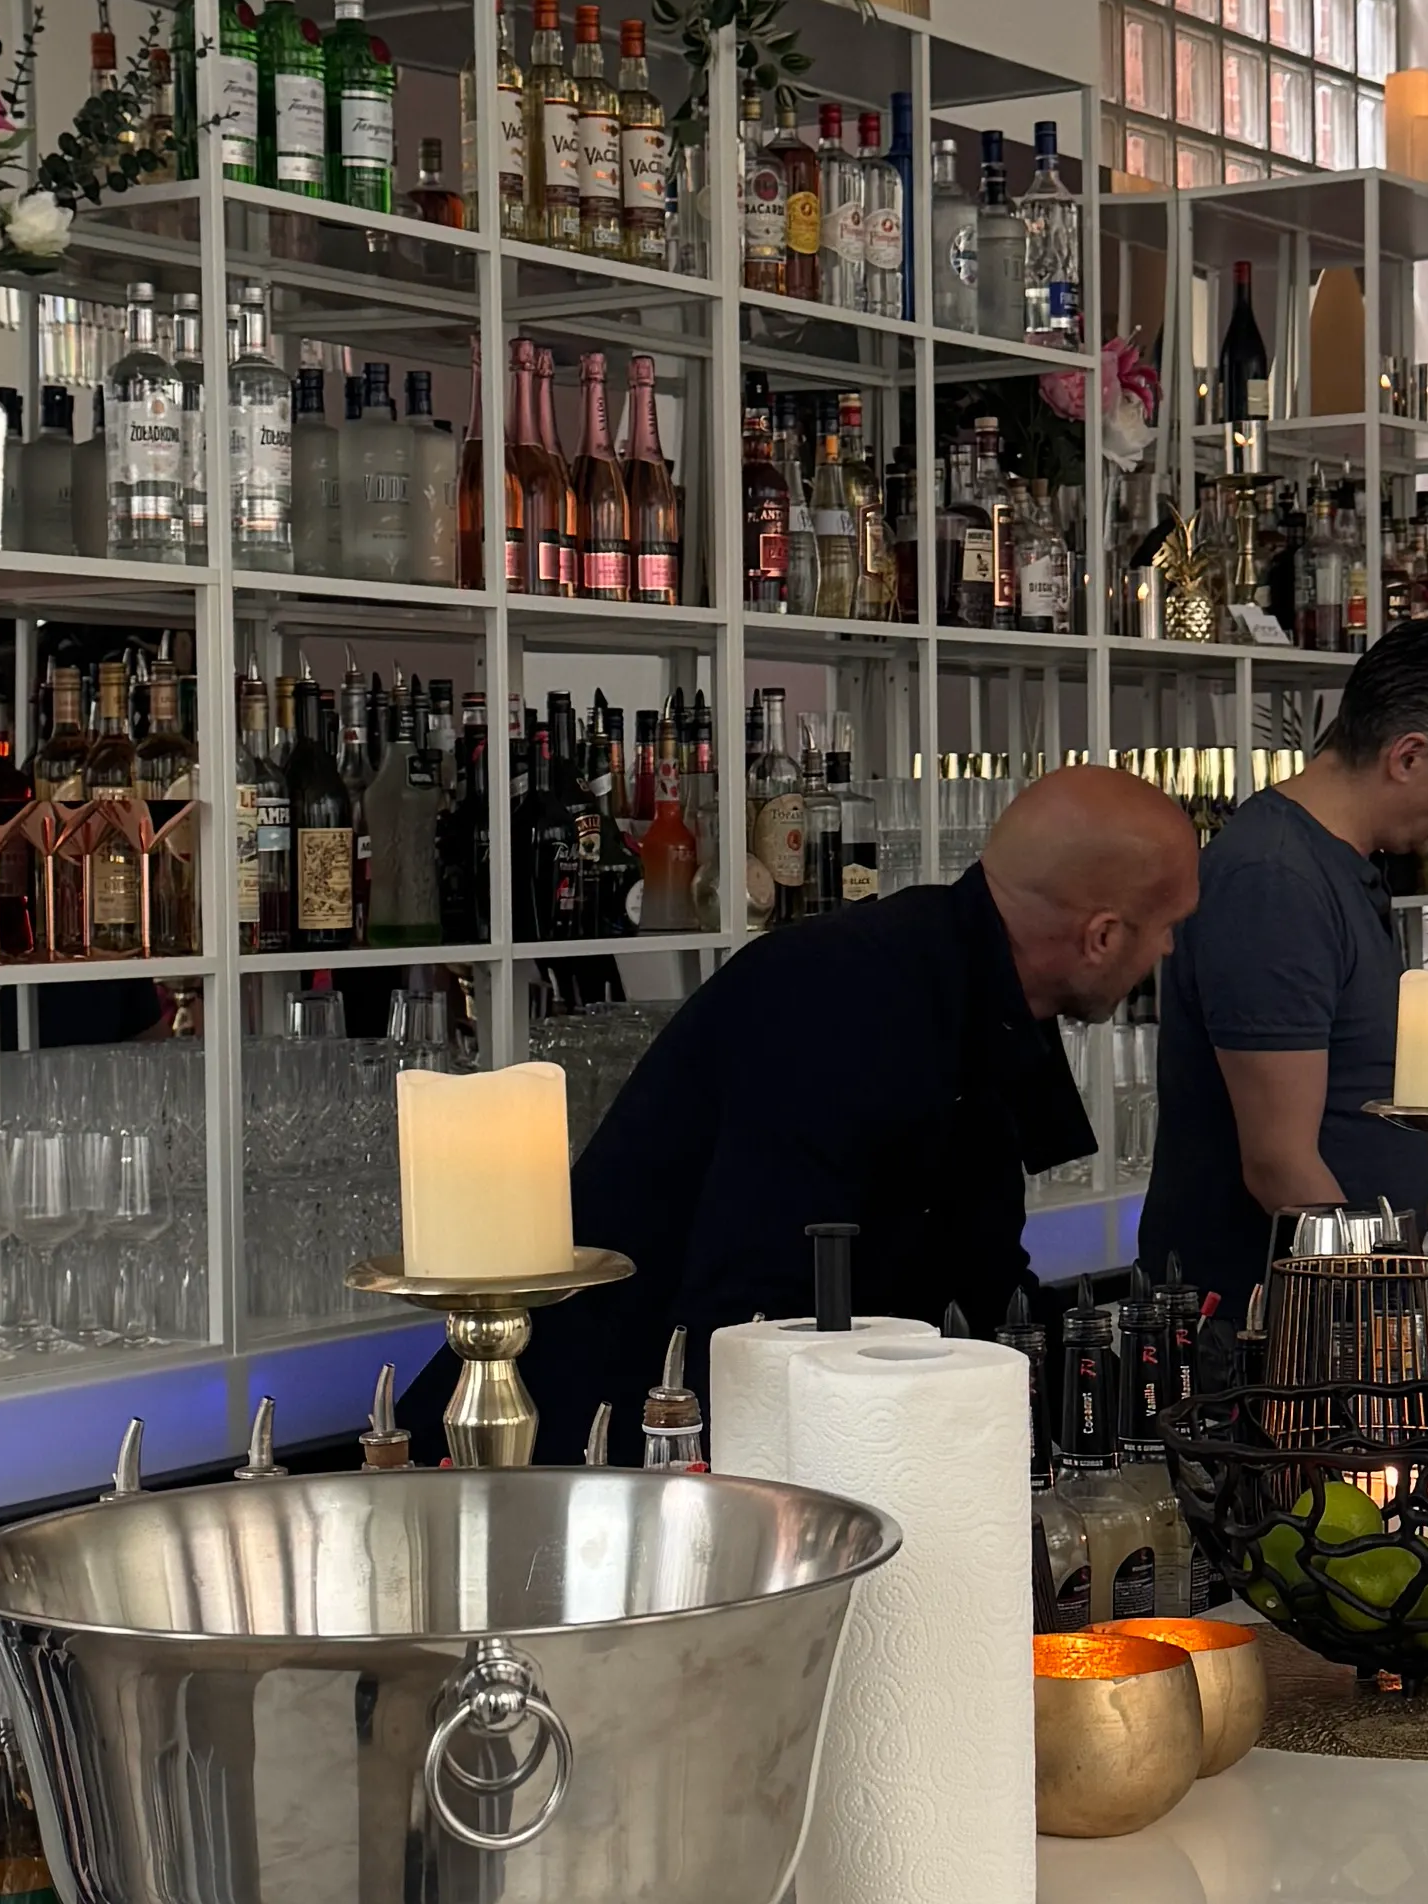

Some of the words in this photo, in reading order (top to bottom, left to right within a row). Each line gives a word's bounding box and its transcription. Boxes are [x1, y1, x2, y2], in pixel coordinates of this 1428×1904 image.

[501, 121, 527, 141] VAC
[552, 135, 579, 154] VAC
[1144, 1382, 1157, 1417] Vanilla
